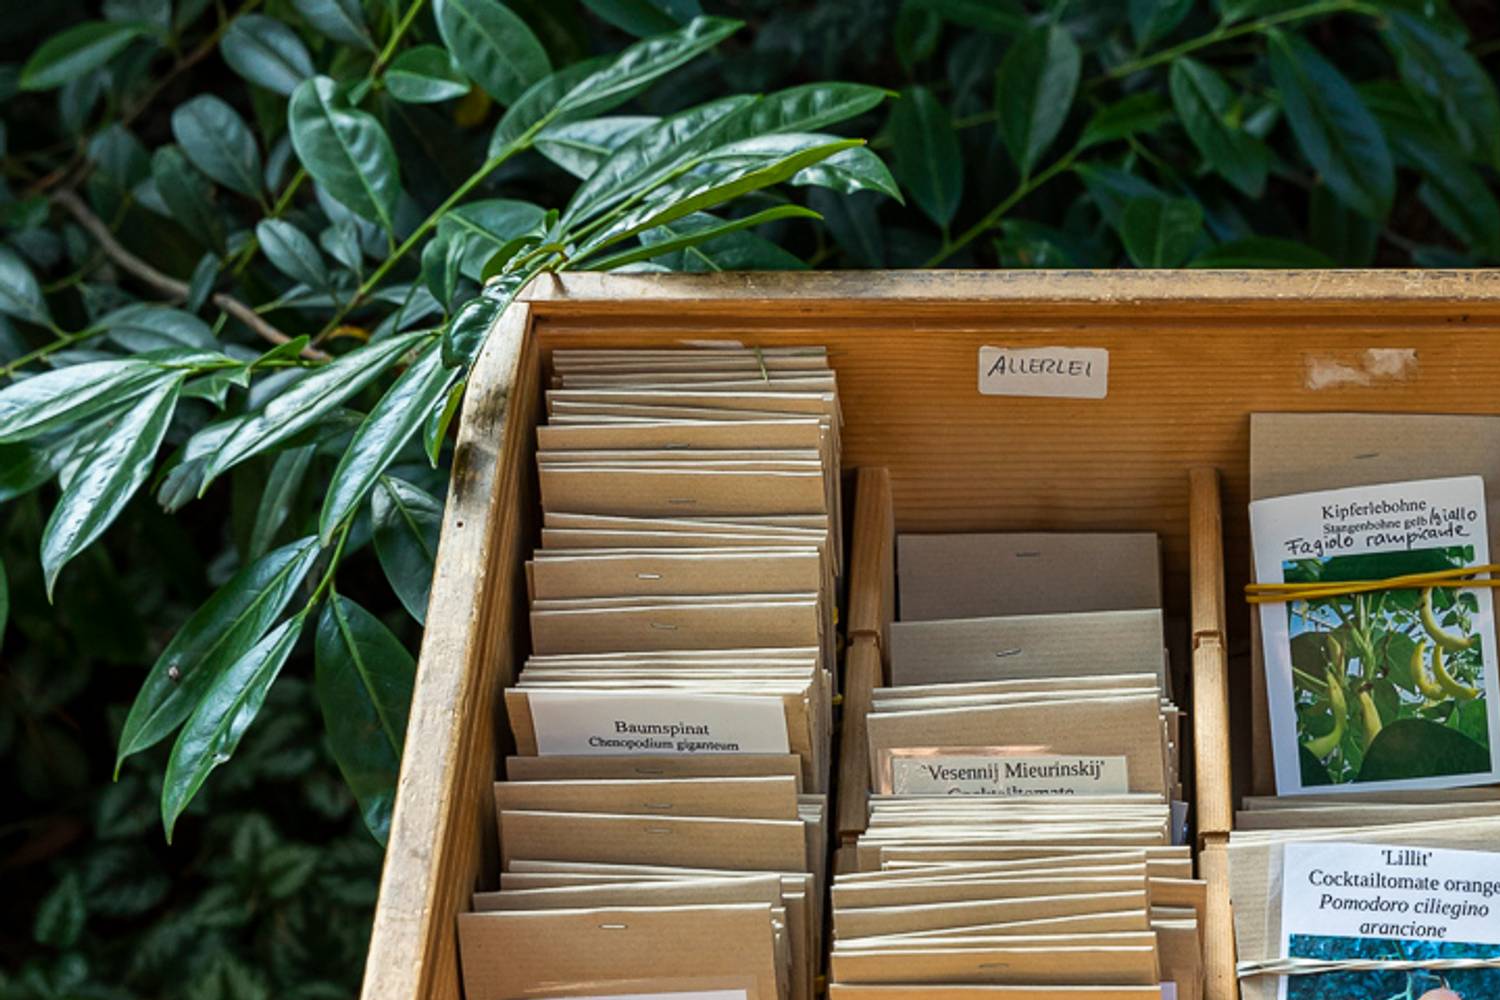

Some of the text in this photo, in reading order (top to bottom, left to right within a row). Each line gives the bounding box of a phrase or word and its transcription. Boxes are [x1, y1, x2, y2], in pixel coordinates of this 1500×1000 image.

[987, 355, 1092, 378] ALLERLEI
[1321, 499, 1428, 521] Kipferlebohne
[1323, 518, 1401, 535] Stangenbohne
[614, 720, 710, 738] Baumspinat
[588, 735, 674, 750] Chenopodium
[1381, 849, 1434, 867] 'Lillit'
[1308, 868, 1440, 891] Cocktailtomate
[1318, 893, 1490, 920] Pomodoro ciliegino
[1358, 921, 1448, 939] arancione
